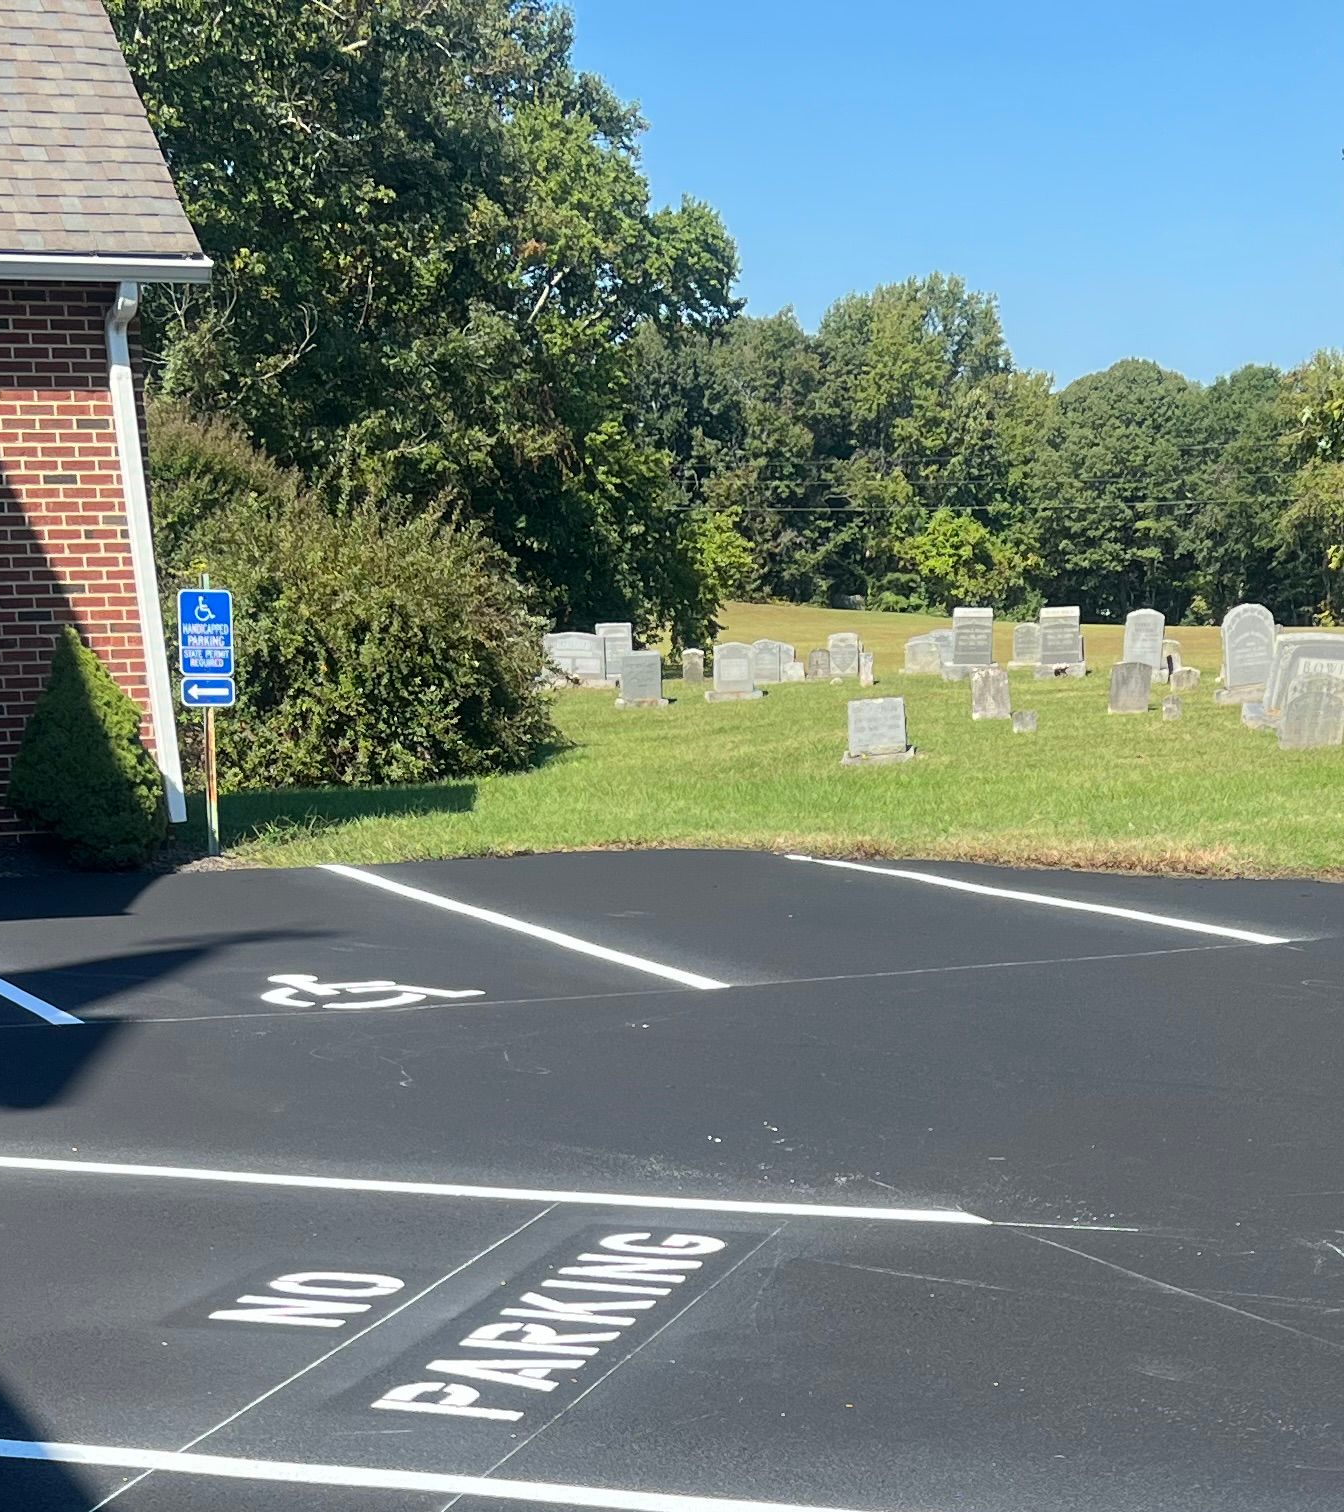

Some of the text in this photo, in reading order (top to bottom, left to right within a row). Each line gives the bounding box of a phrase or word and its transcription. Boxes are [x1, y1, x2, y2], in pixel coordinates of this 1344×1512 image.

[182, 623, 229, 635] HANDICAPPED
[187, 635, 225, 647] PARKING
[183, 649, 229, 659] STATE PERMIT
[189, 658, 224, 668] REQUIRED
[208, 1271, 406, 1328] NO
[370, 1231, 728, 1422] PARKING
